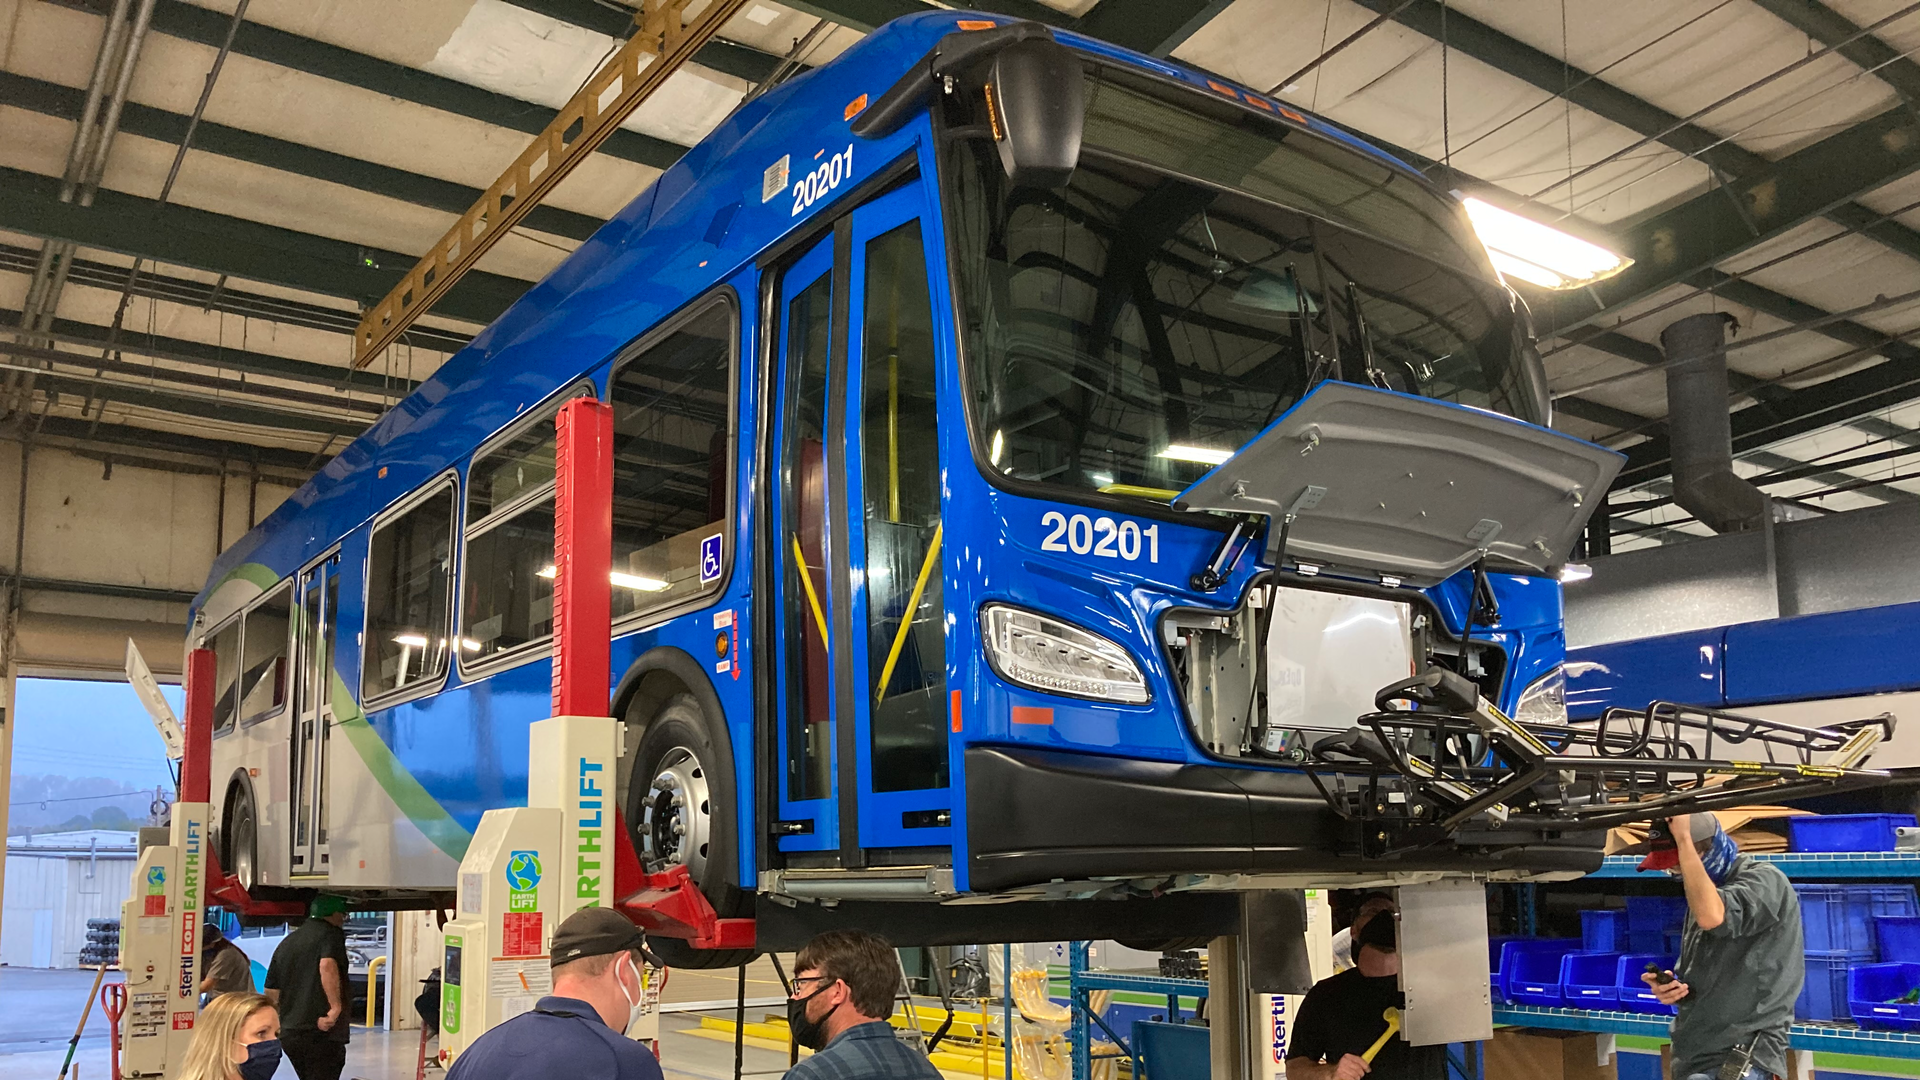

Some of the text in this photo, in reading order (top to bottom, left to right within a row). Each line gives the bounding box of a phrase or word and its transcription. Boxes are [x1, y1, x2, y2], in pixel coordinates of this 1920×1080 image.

[791, 143, 853, 217] 20201
[1041, 511, 1159, 564] 20201
[577, 757, 603, 911] RTHLIFT
[179, 819, 200, 998] stertil KONI EARTHLIFT
[511, 899, 535, 908] LIFT
[174, 1013, 193, 1021] 18500
[177, 1021, 189, 1029] lbs
[1271, 996, 1287, 1062] stertil
